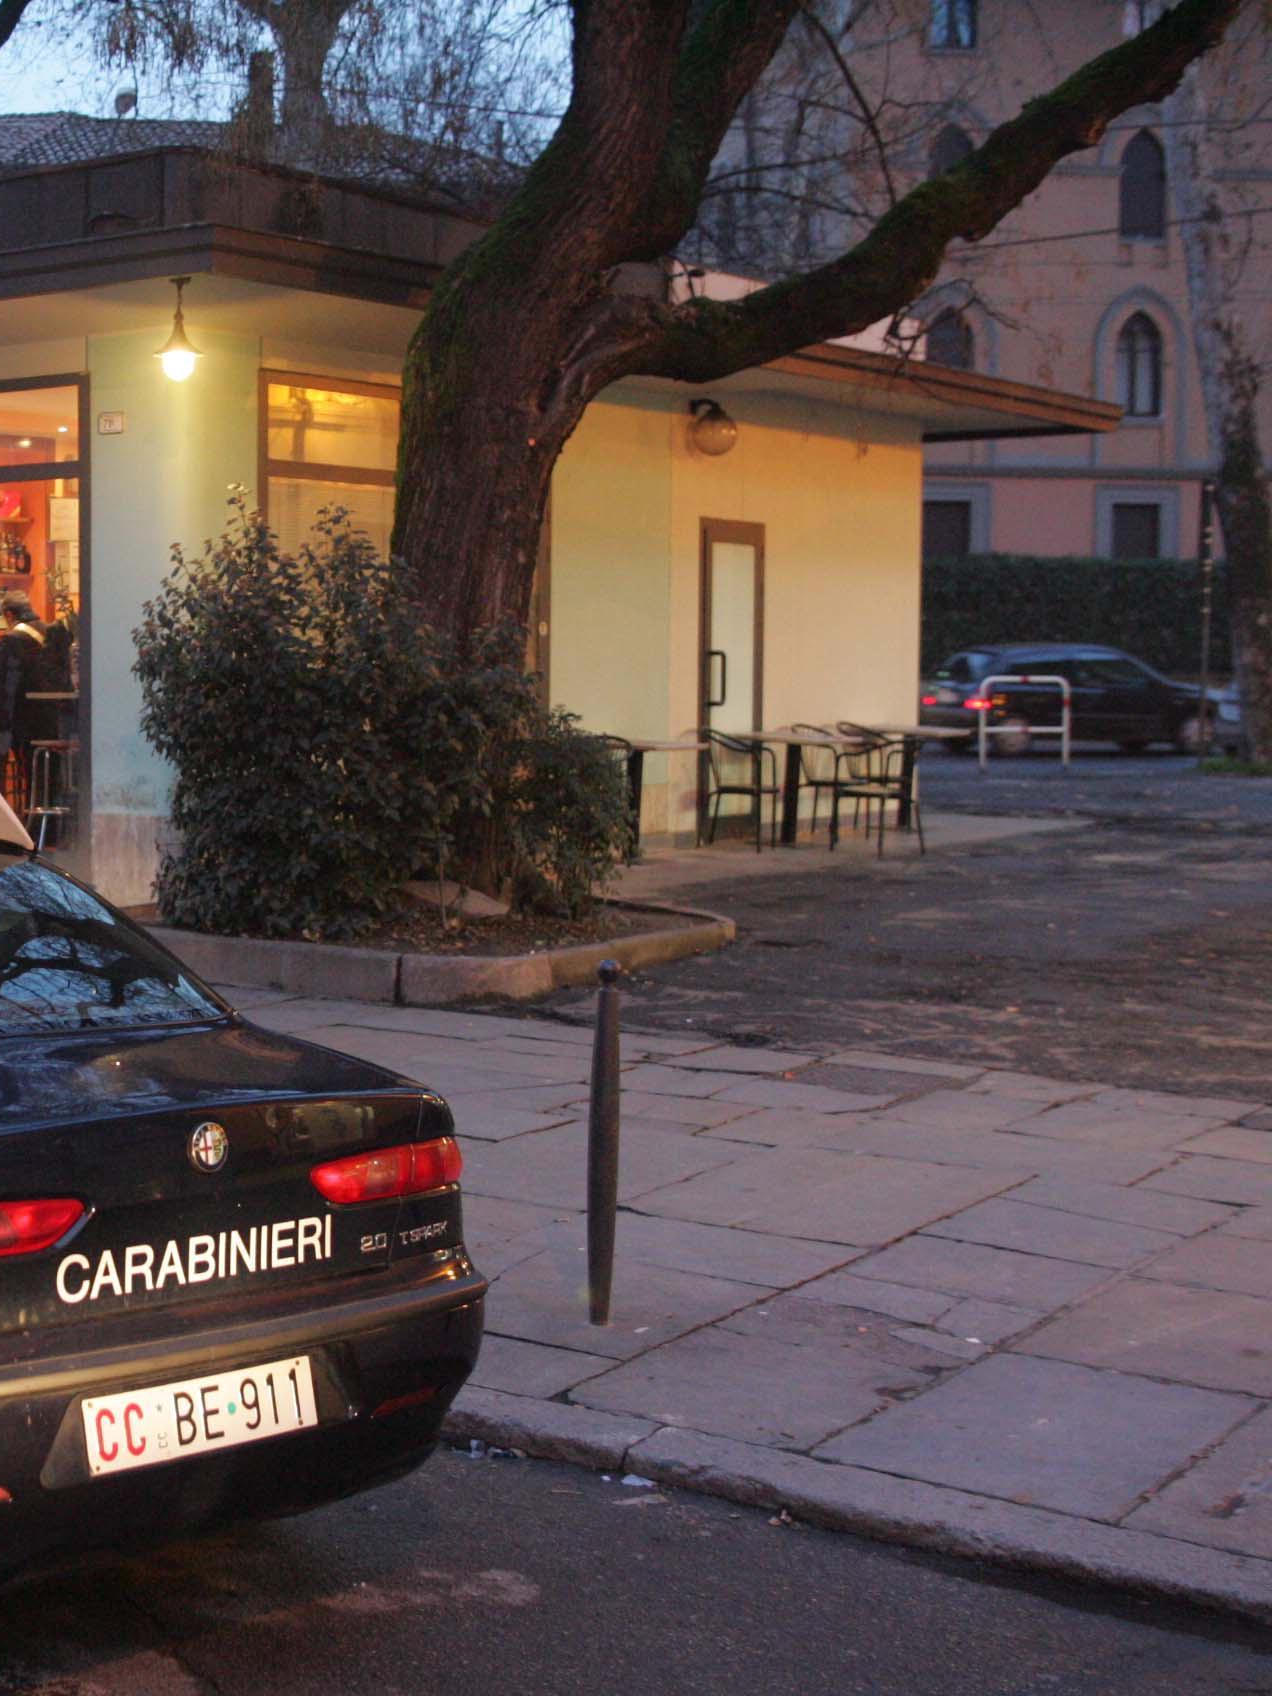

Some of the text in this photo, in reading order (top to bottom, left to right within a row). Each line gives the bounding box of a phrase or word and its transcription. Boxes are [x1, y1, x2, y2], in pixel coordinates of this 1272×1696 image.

[55, 1213, 332, 1303] CARABINIERI
[95, 1367, 303, 1462] CC BE 911
